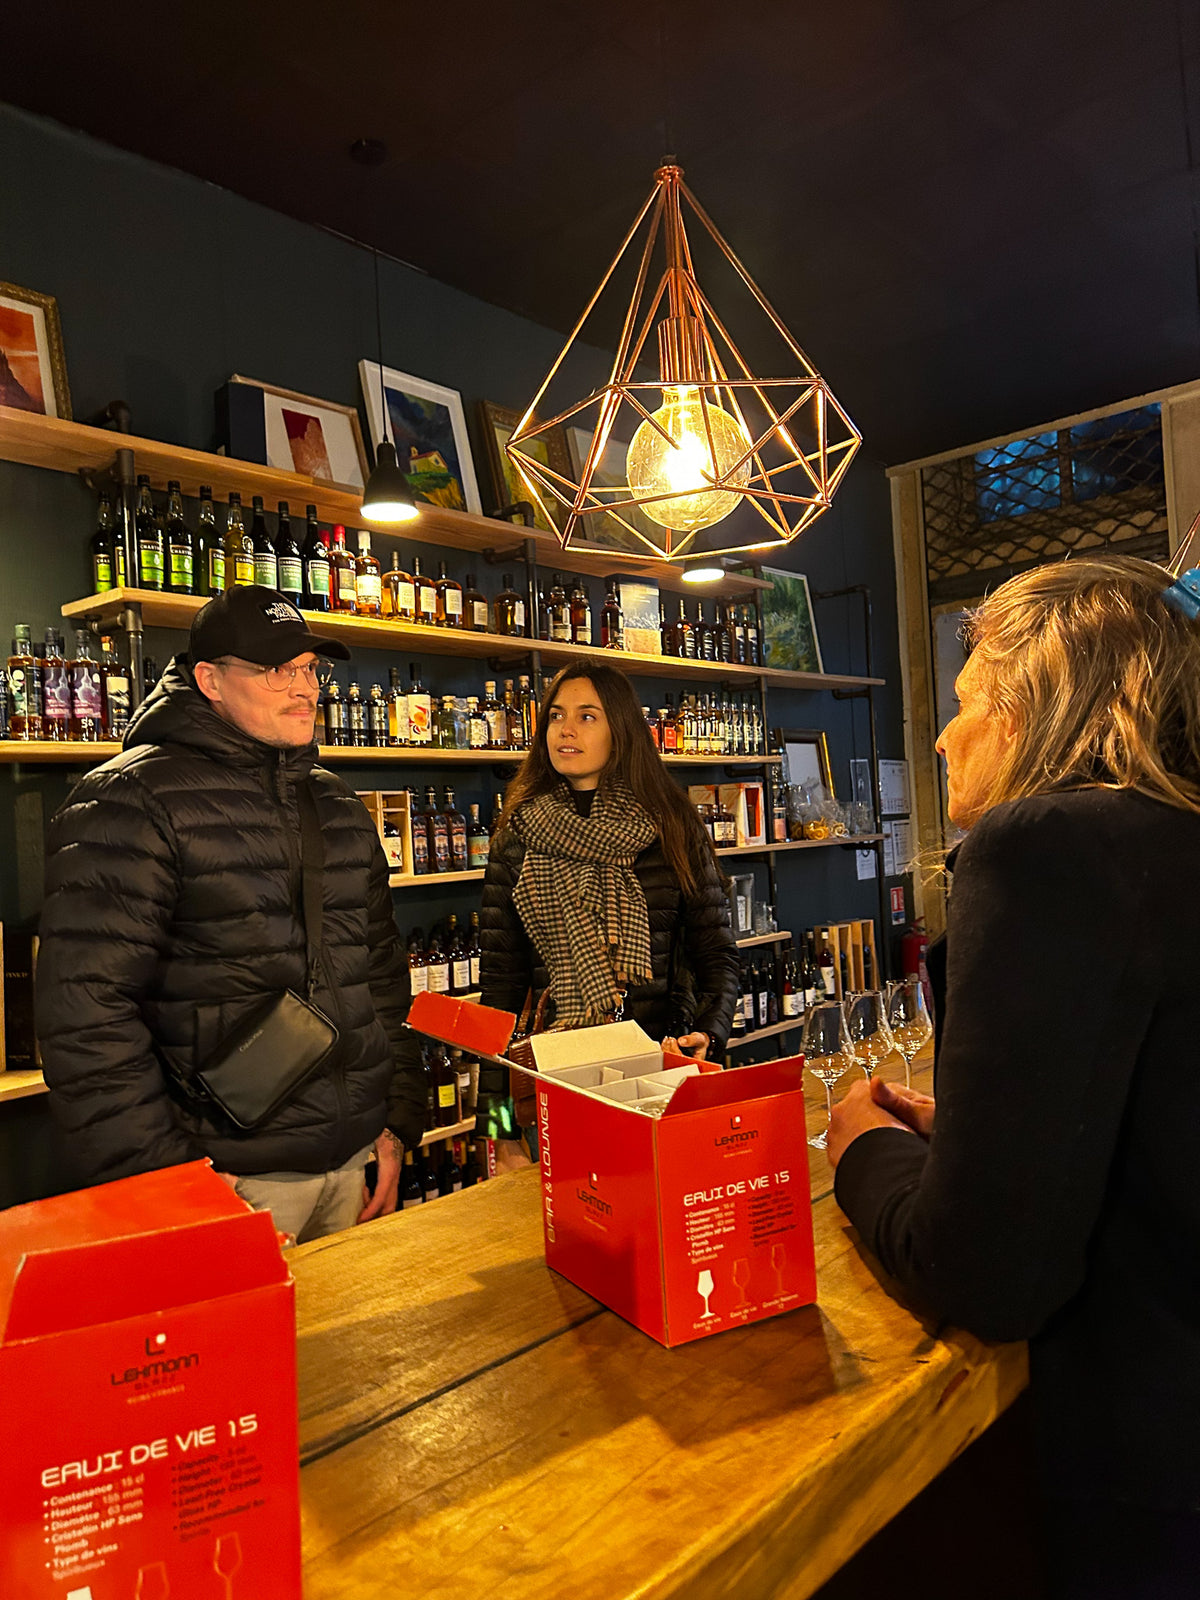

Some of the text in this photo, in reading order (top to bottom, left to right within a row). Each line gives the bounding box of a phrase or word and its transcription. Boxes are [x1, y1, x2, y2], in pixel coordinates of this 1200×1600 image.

[540, 1092, 552, 1177] LOUNGE
[726, 1181, 746, 1196] DE
[748, 1175, 770, 1191] VIE
[774, 1170, 790, 1184] 15
[129, 1438, 169, 1465] DE
[175, 1424, 216, 1452] VIE
[228, 1413, 258, 1437] 15
